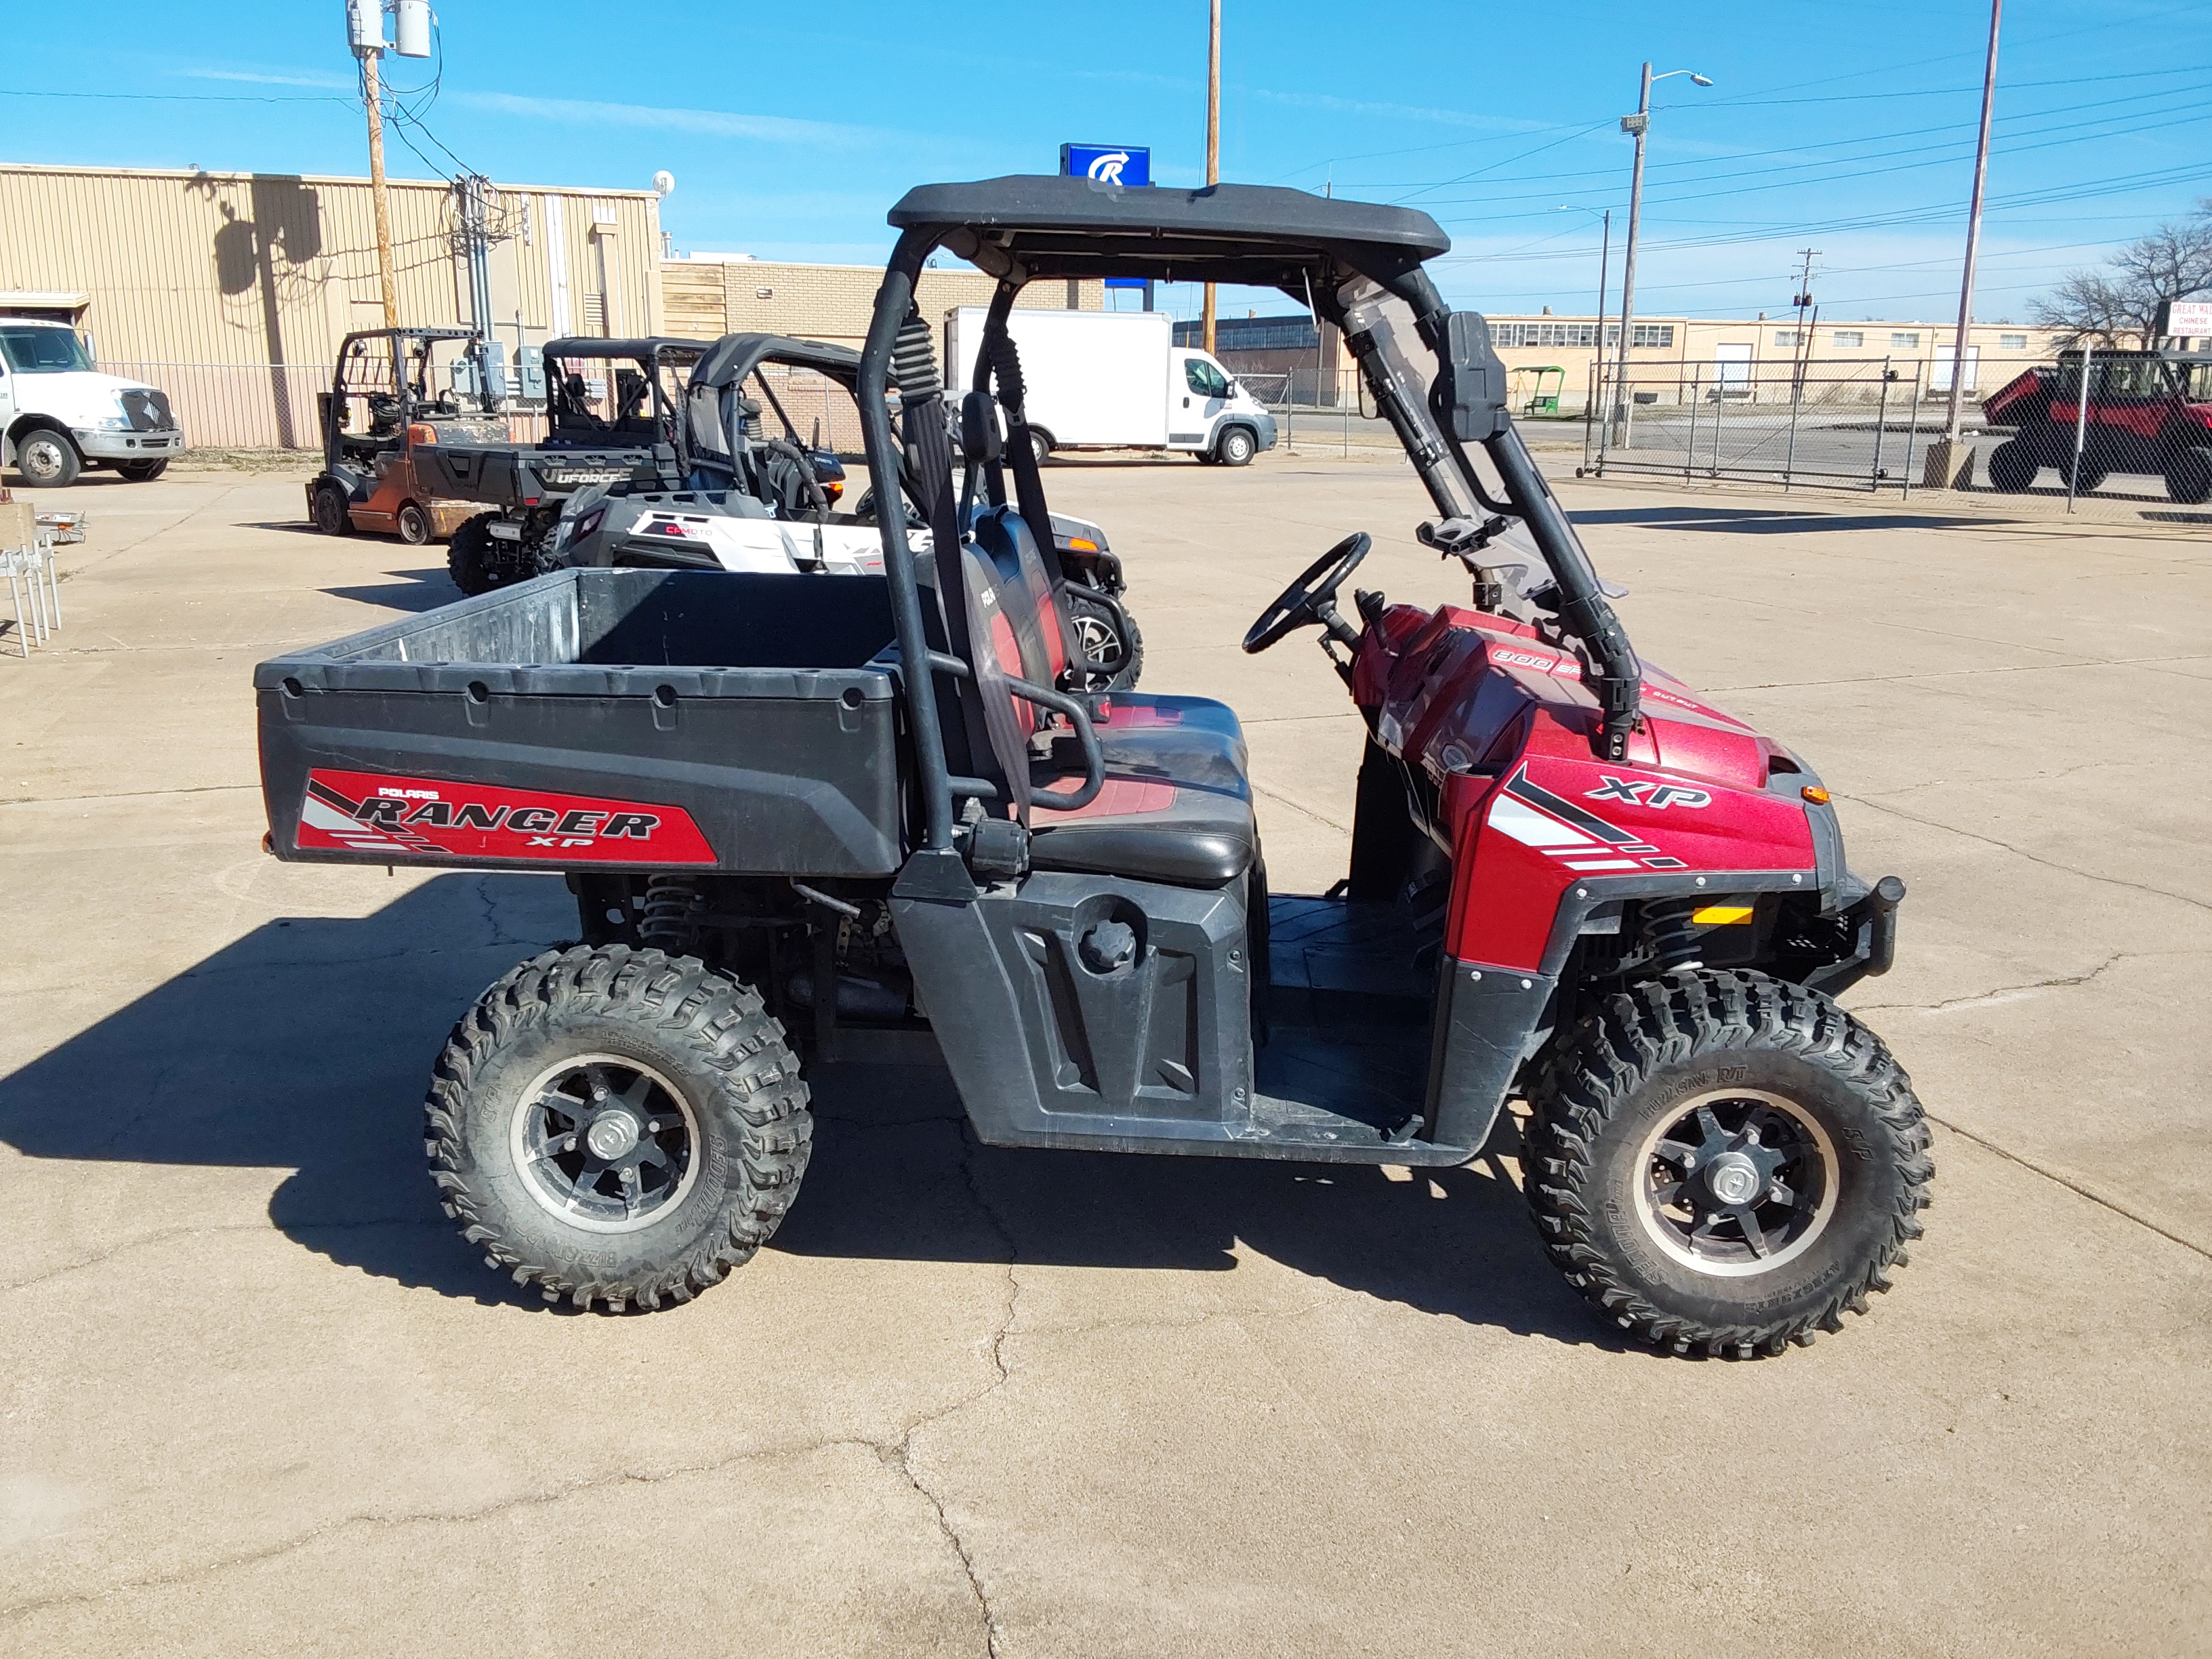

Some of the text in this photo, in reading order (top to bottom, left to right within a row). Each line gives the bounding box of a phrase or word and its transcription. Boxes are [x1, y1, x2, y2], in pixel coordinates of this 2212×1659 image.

[2172, 304, 2196, 314] GREAT
[2179, 316, 2208, 325] CHINESE
[2173, 327, 2211, 335] RESTAURANT
[558, 474, 621, 484] UFORCE
[1492, 649, 1555, 672] 800
[377, 787, 440, 800] POLARIS
[1582, 775, 1713, 810] XP
[354, 796, 661, 840] RANGER
[525, 836, 594, 848] XP
